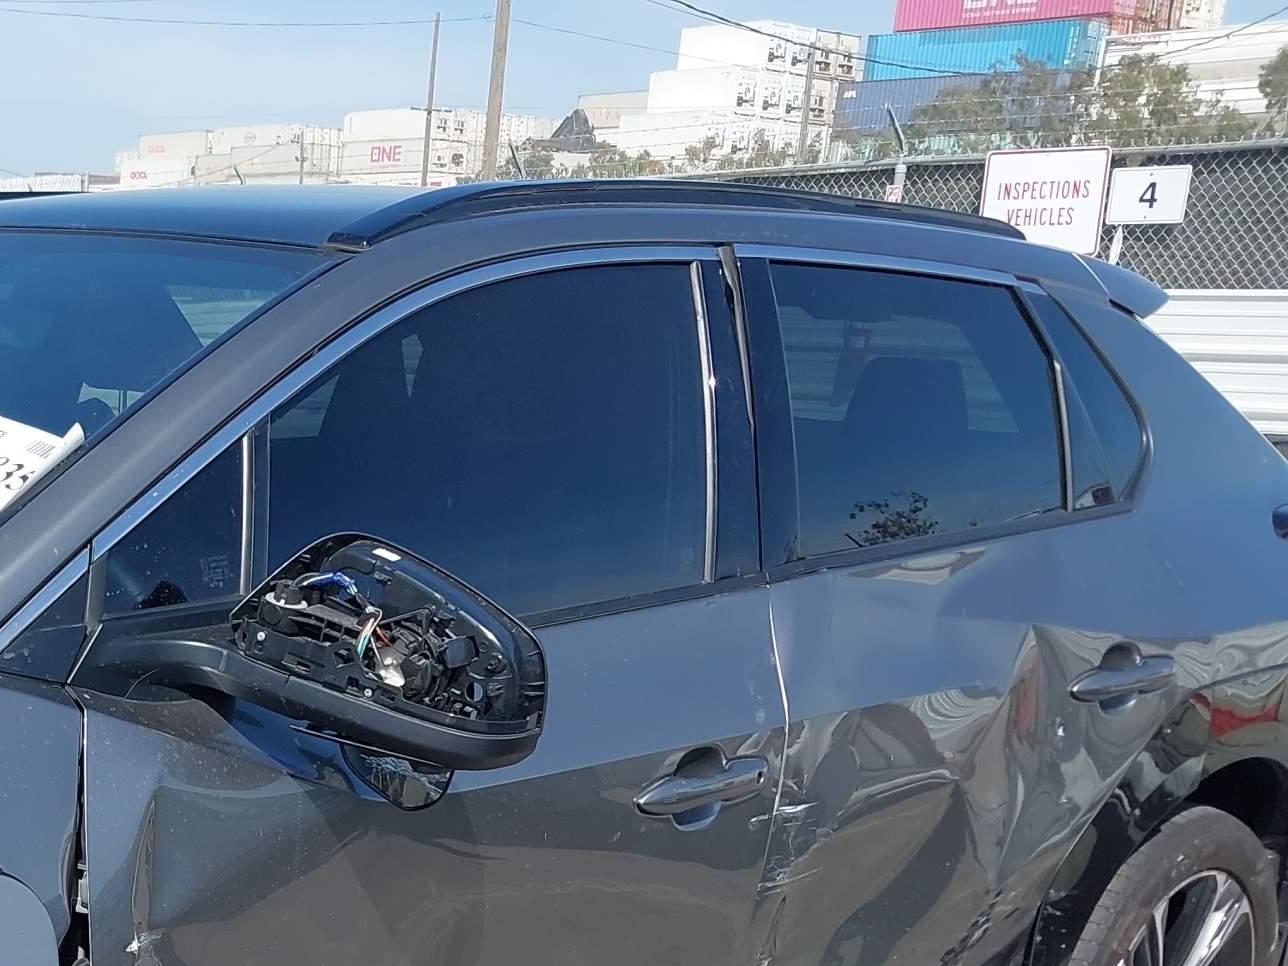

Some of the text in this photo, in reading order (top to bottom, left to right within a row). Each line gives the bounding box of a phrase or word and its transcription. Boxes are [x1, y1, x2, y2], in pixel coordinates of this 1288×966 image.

[370, 144, 403, 163] ONE
[997, 179, 1091, 201] INSPECTIONS
[1138, 181, 1158, 209] 4
[1007, 207, 1074, 227] VEHICLES
